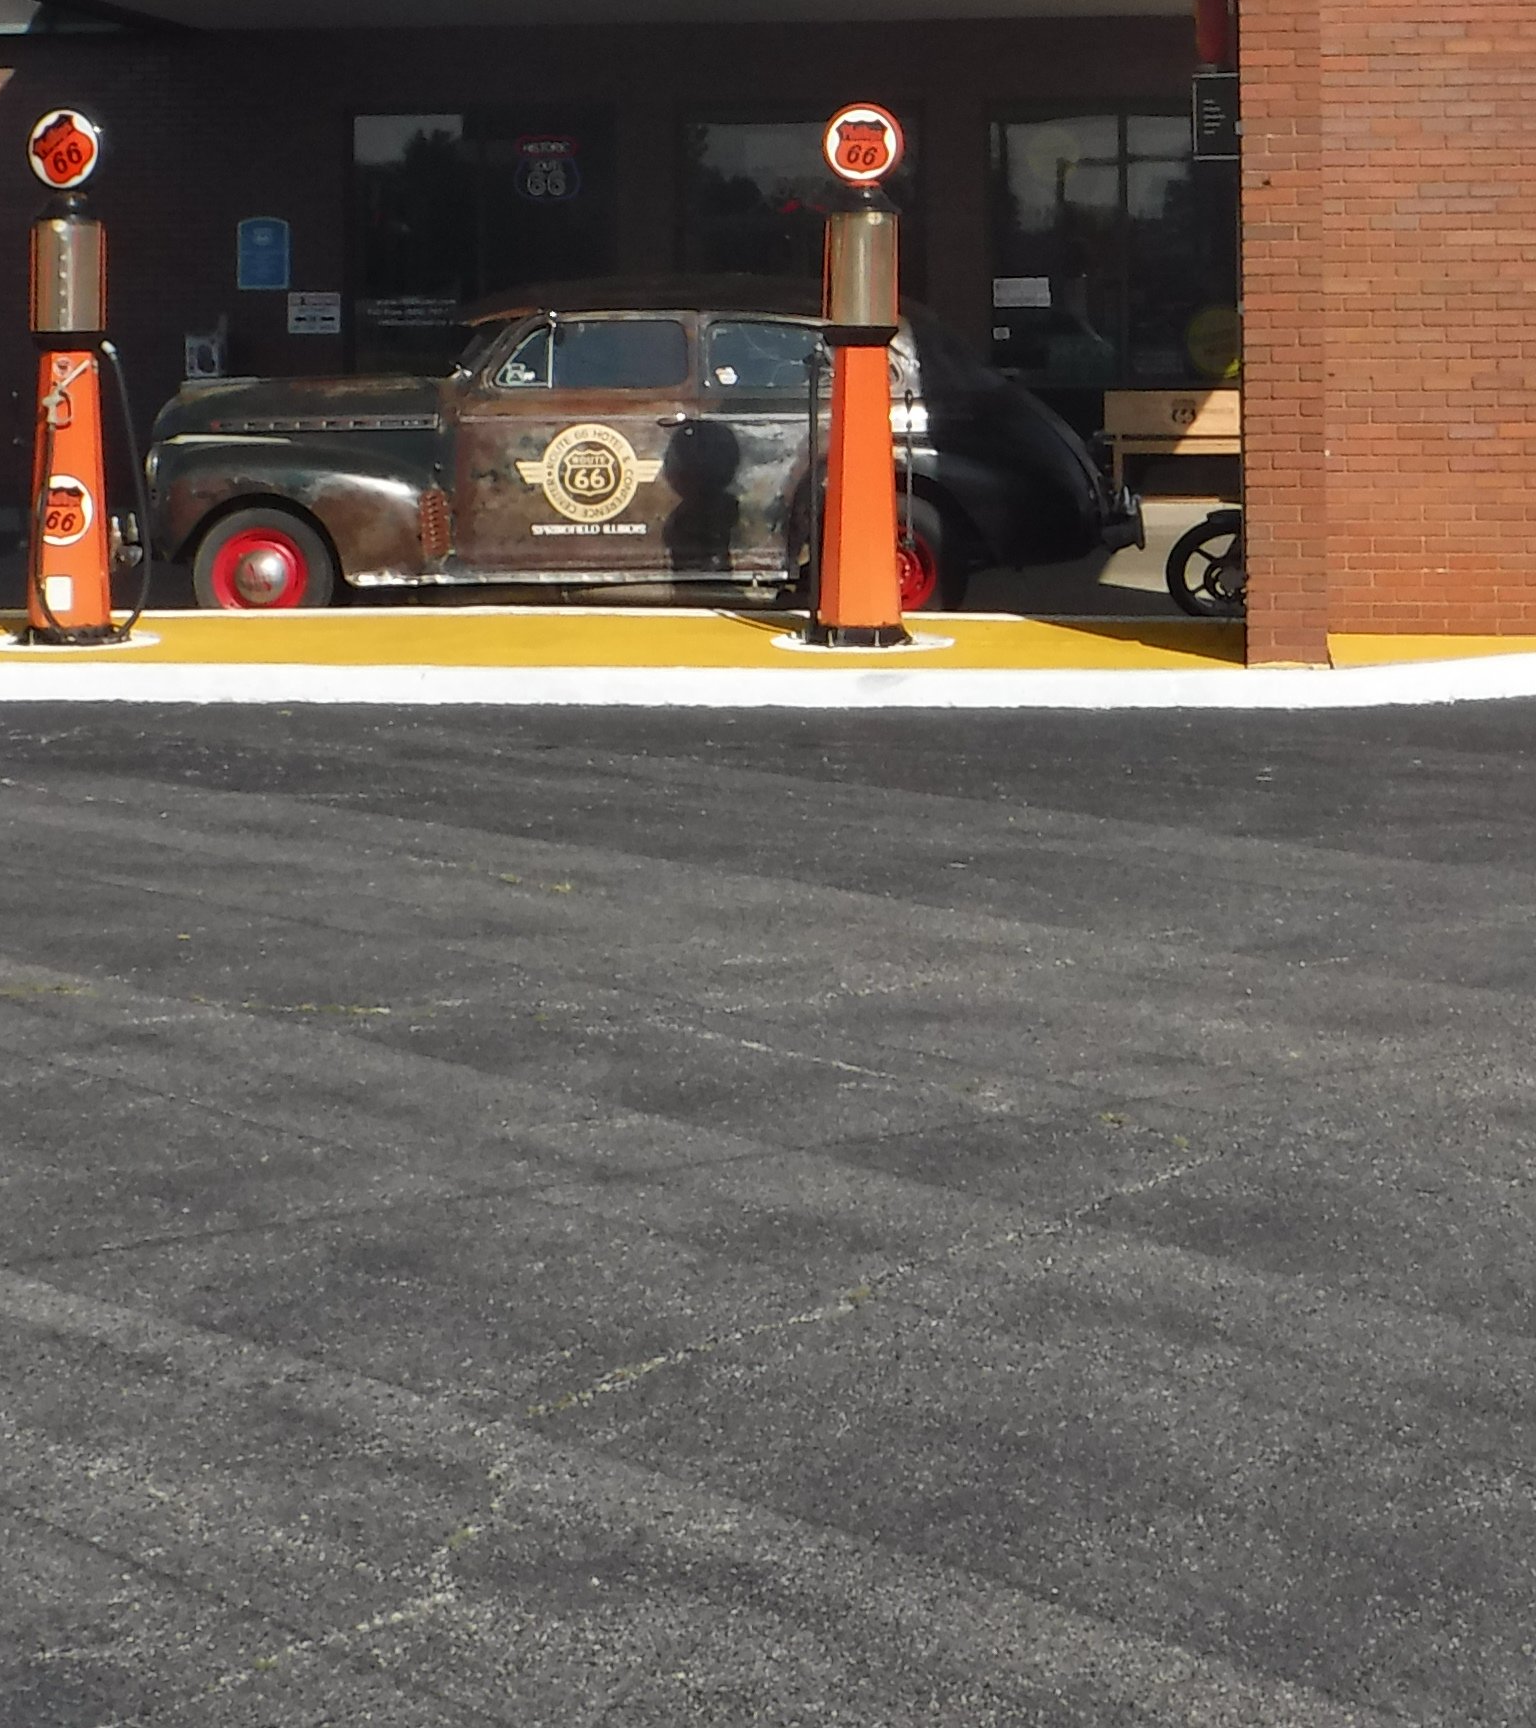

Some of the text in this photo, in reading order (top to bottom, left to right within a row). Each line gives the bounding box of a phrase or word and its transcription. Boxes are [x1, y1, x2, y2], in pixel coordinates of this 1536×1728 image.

[52, 141, 83, 174] 66
[846, 144, 878, 166] 66
[527, 170, 566, 196] 66
[574, 468, 606, 489] 66
[46, 510, 77, 532] 66
